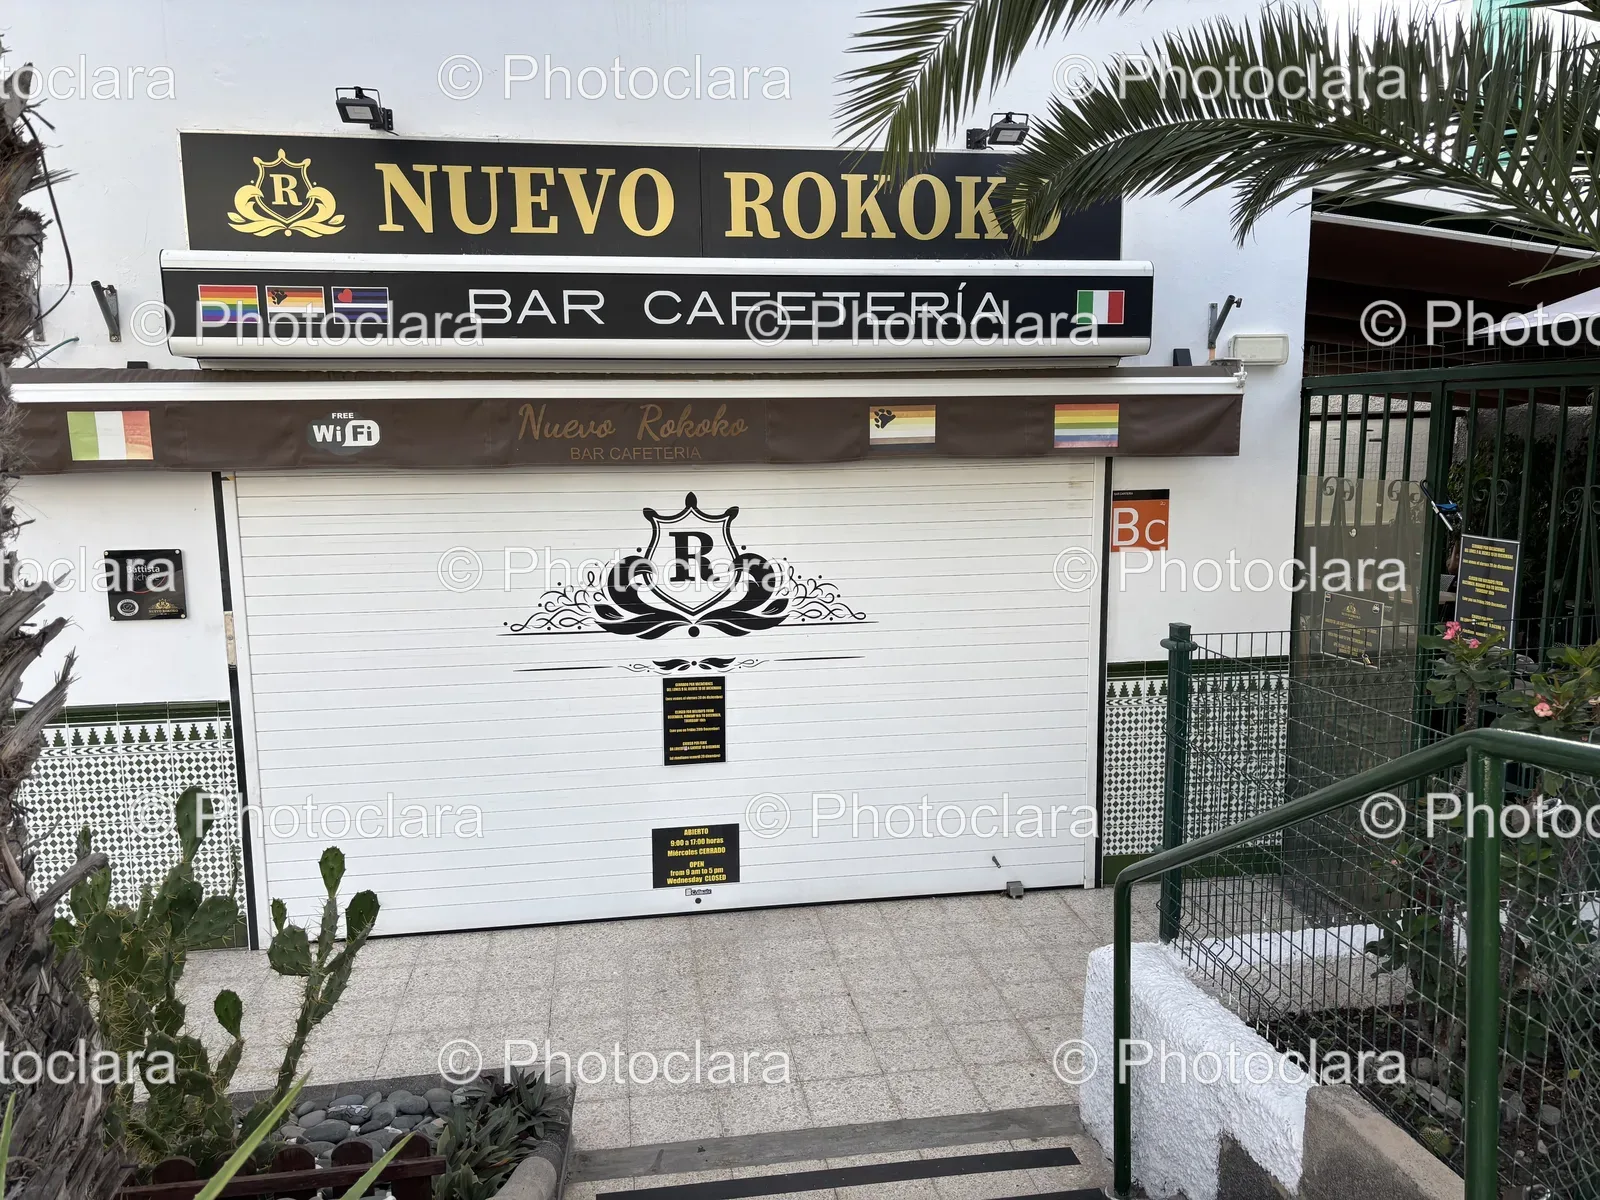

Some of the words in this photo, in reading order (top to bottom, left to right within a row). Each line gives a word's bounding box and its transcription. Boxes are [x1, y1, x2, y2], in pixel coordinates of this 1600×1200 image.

[270, 174, 303, 206] R
[375, 162, 675, 237] NUEVO
[468, 289, 605, 325] BAR
[644, 282, 1006, 326] CAFETERÍA
[518, 403, 616, 440] Nuevo
[636, 403, 748, 441] Rokoko
[570, 447, 604, 460] BAR
[609, 446, 701, 460] CAFETERIA
[669, 531, 720, 582] R
[127, 565, 160, 573] Battista
[684, 828, 708, 836] ABIERTO
[670, 839, 684, 847] 9:00
[686, 868, 690, 876] 9
[666, 876, 703, 885] Wednesday
[704, 874, 726, 882] CLOSED
